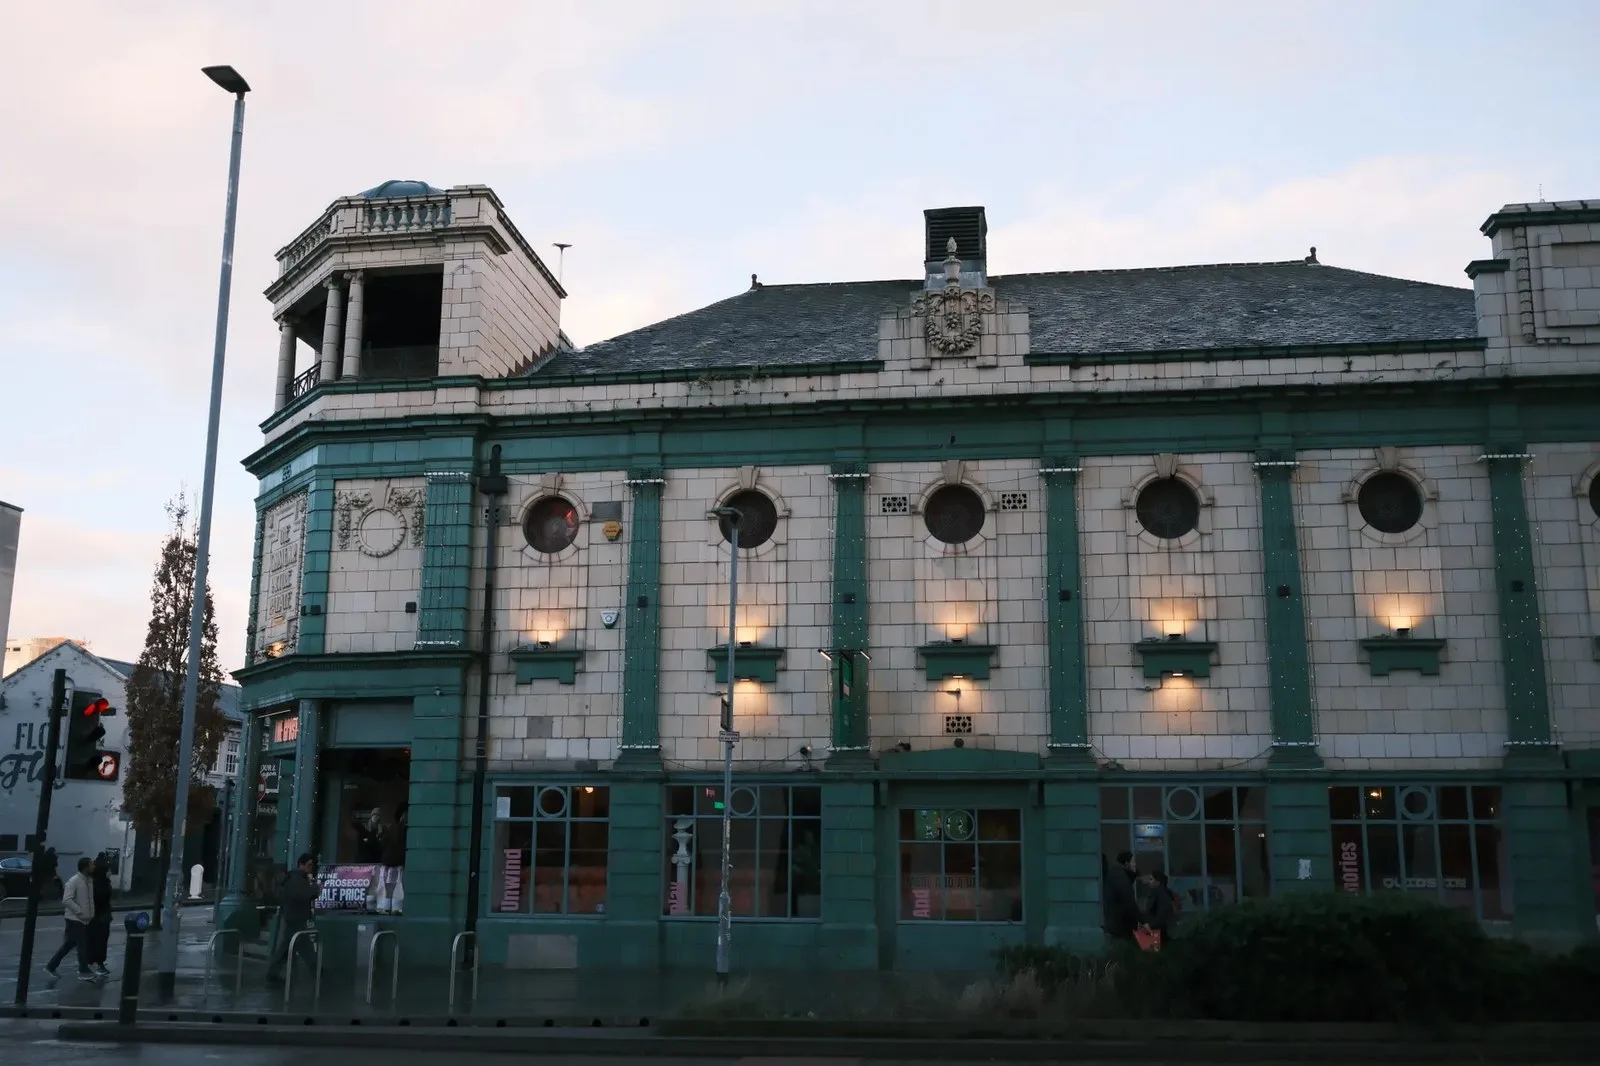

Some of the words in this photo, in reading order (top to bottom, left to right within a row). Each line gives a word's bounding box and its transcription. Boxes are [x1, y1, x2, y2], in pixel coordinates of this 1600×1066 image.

[324, 878, 370, 887] PROSECCO
[500, 848, 521, 912] Unwind
[339, 888, 365, 901] PRICE
[314, 901, 345, 909] EVERY
[345, 901, 365, 909] DAY
